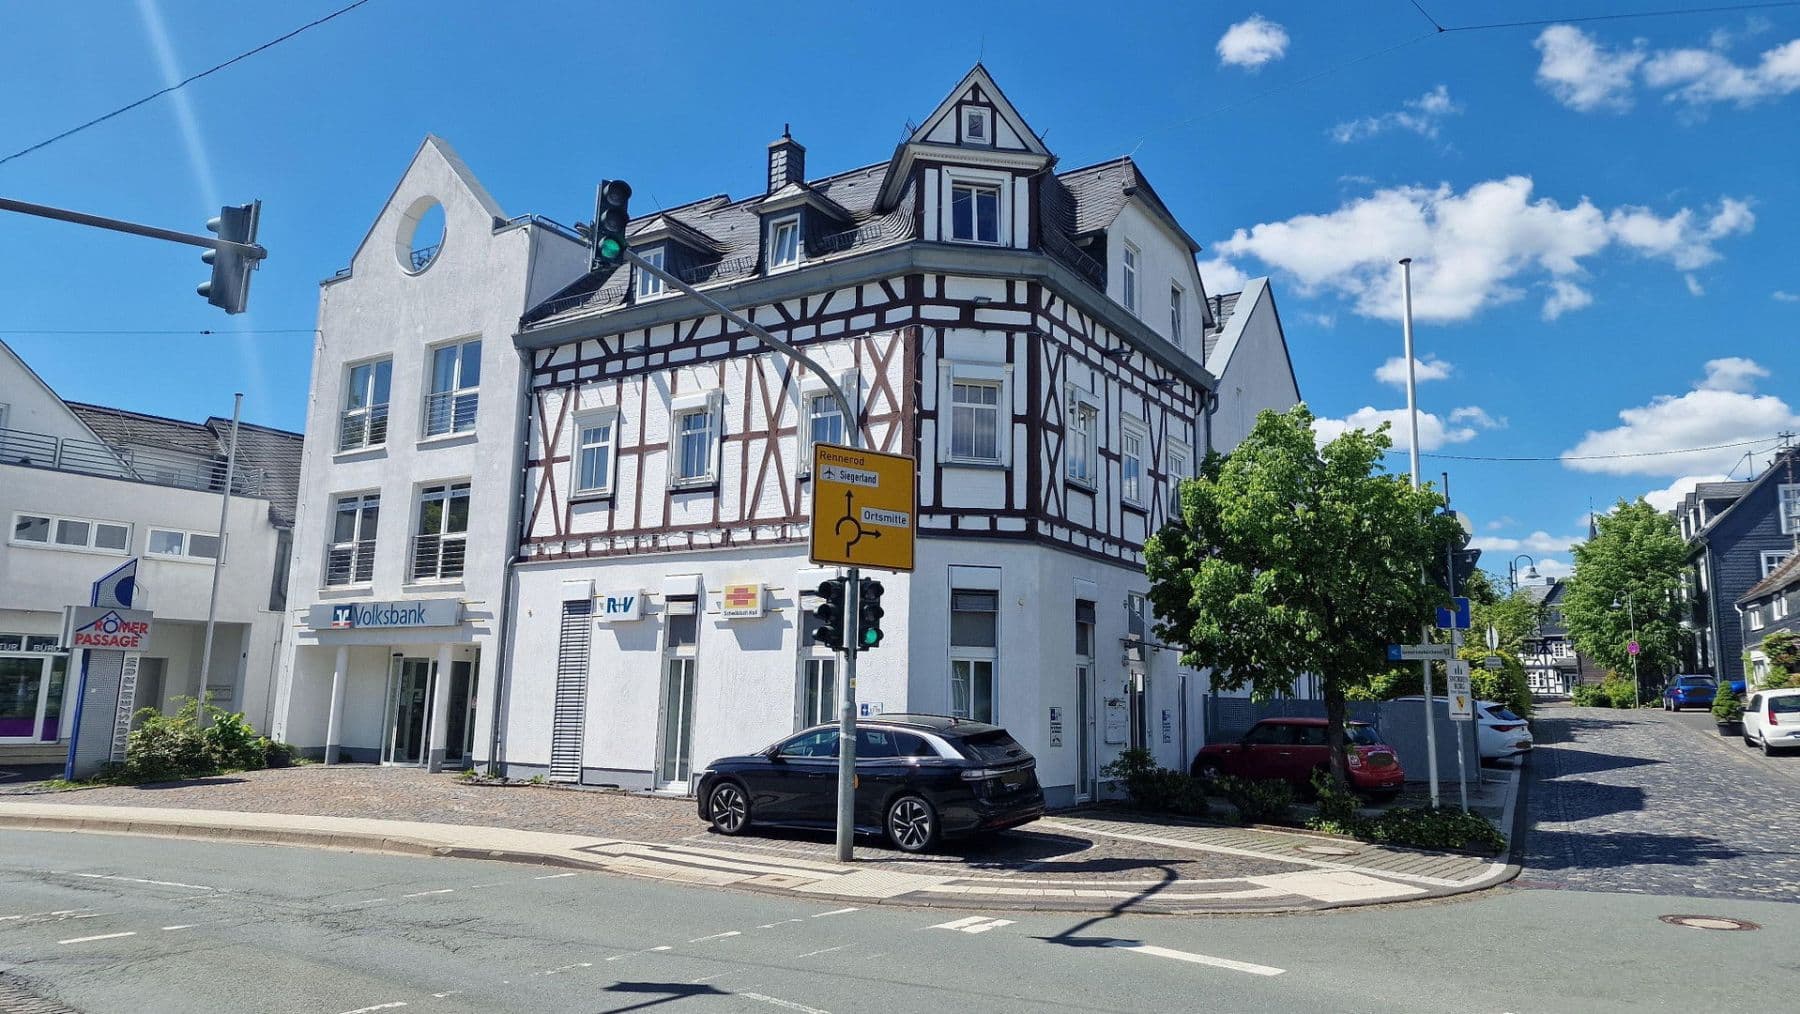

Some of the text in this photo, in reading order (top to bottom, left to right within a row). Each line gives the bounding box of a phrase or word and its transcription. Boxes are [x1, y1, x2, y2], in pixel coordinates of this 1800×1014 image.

[820, 450, 865, 466] Rennerod
[840, 470, 877, 484] Siegerland
[864, 510, 907, 525] Ortsmitte
[606, 596, 635, 614] R+V
[354, 602, 426, 625] Volksbank
[94, 617, 149, 634] RÖMER
[74, 633, 139, 648] PASSAGE
